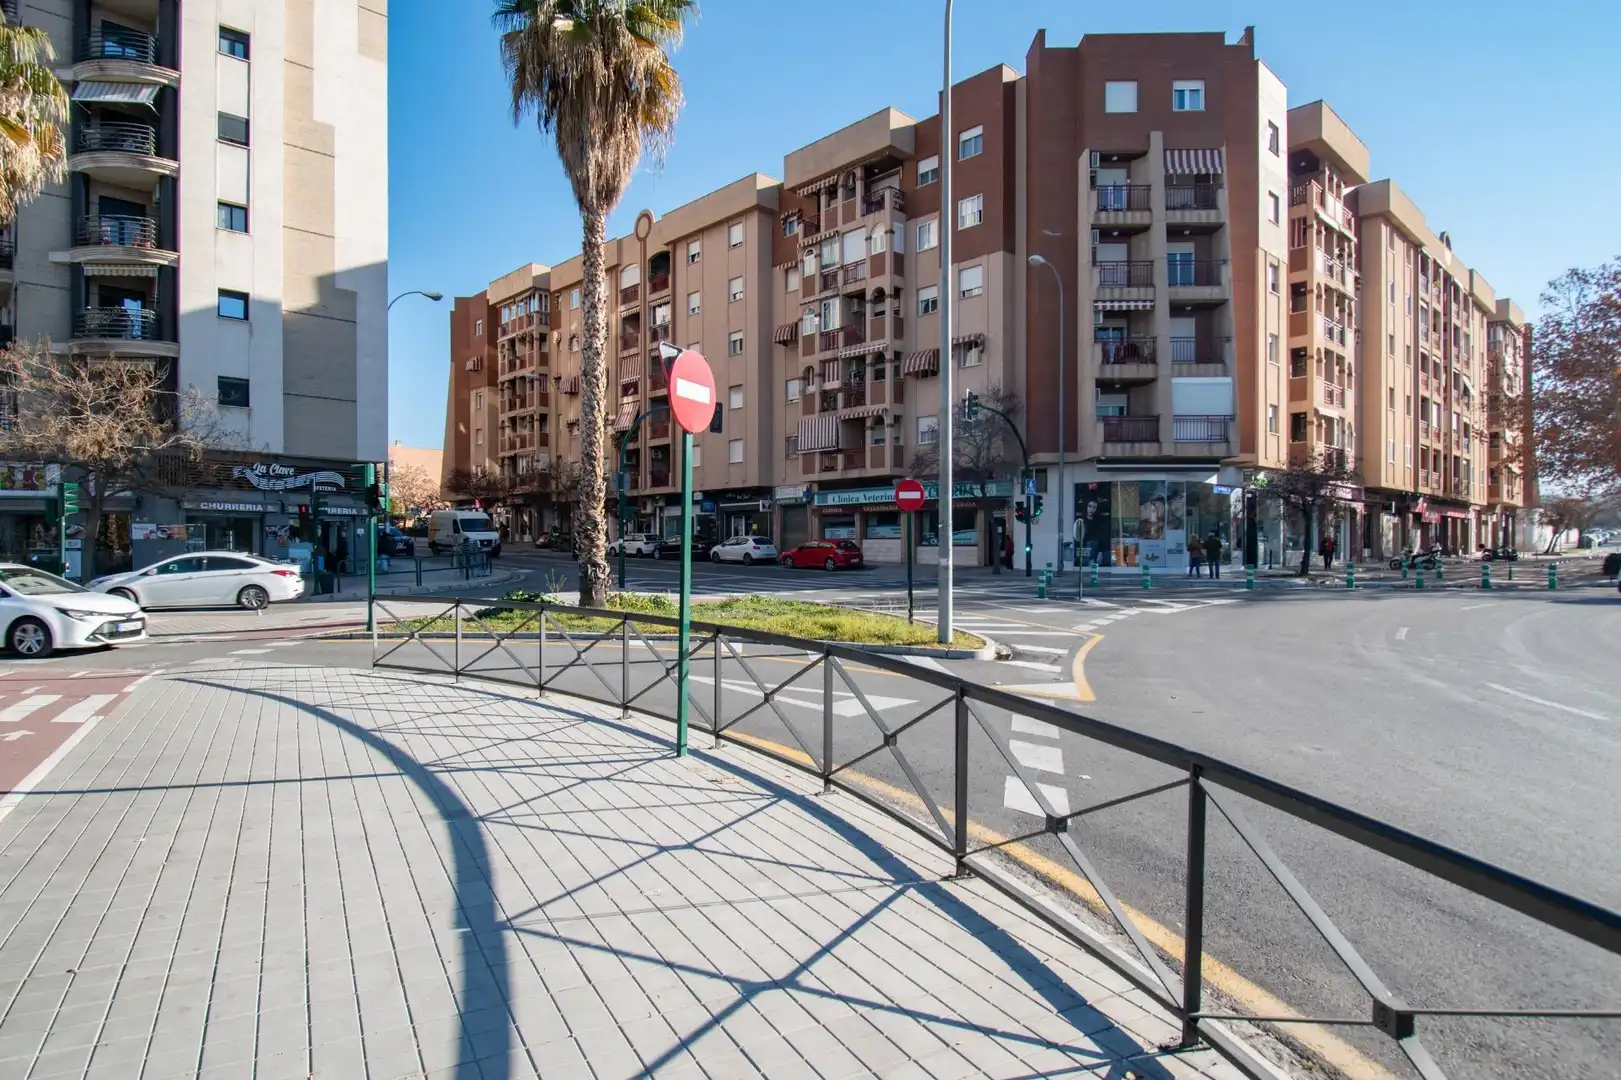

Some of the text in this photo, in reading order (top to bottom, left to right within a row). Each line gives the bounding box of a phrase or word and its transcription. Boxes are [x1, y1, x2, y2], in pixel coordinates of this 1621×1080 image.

[253, 463, 295, 475] La Clave
[200, 501, 264, 512] CHURRERIA
